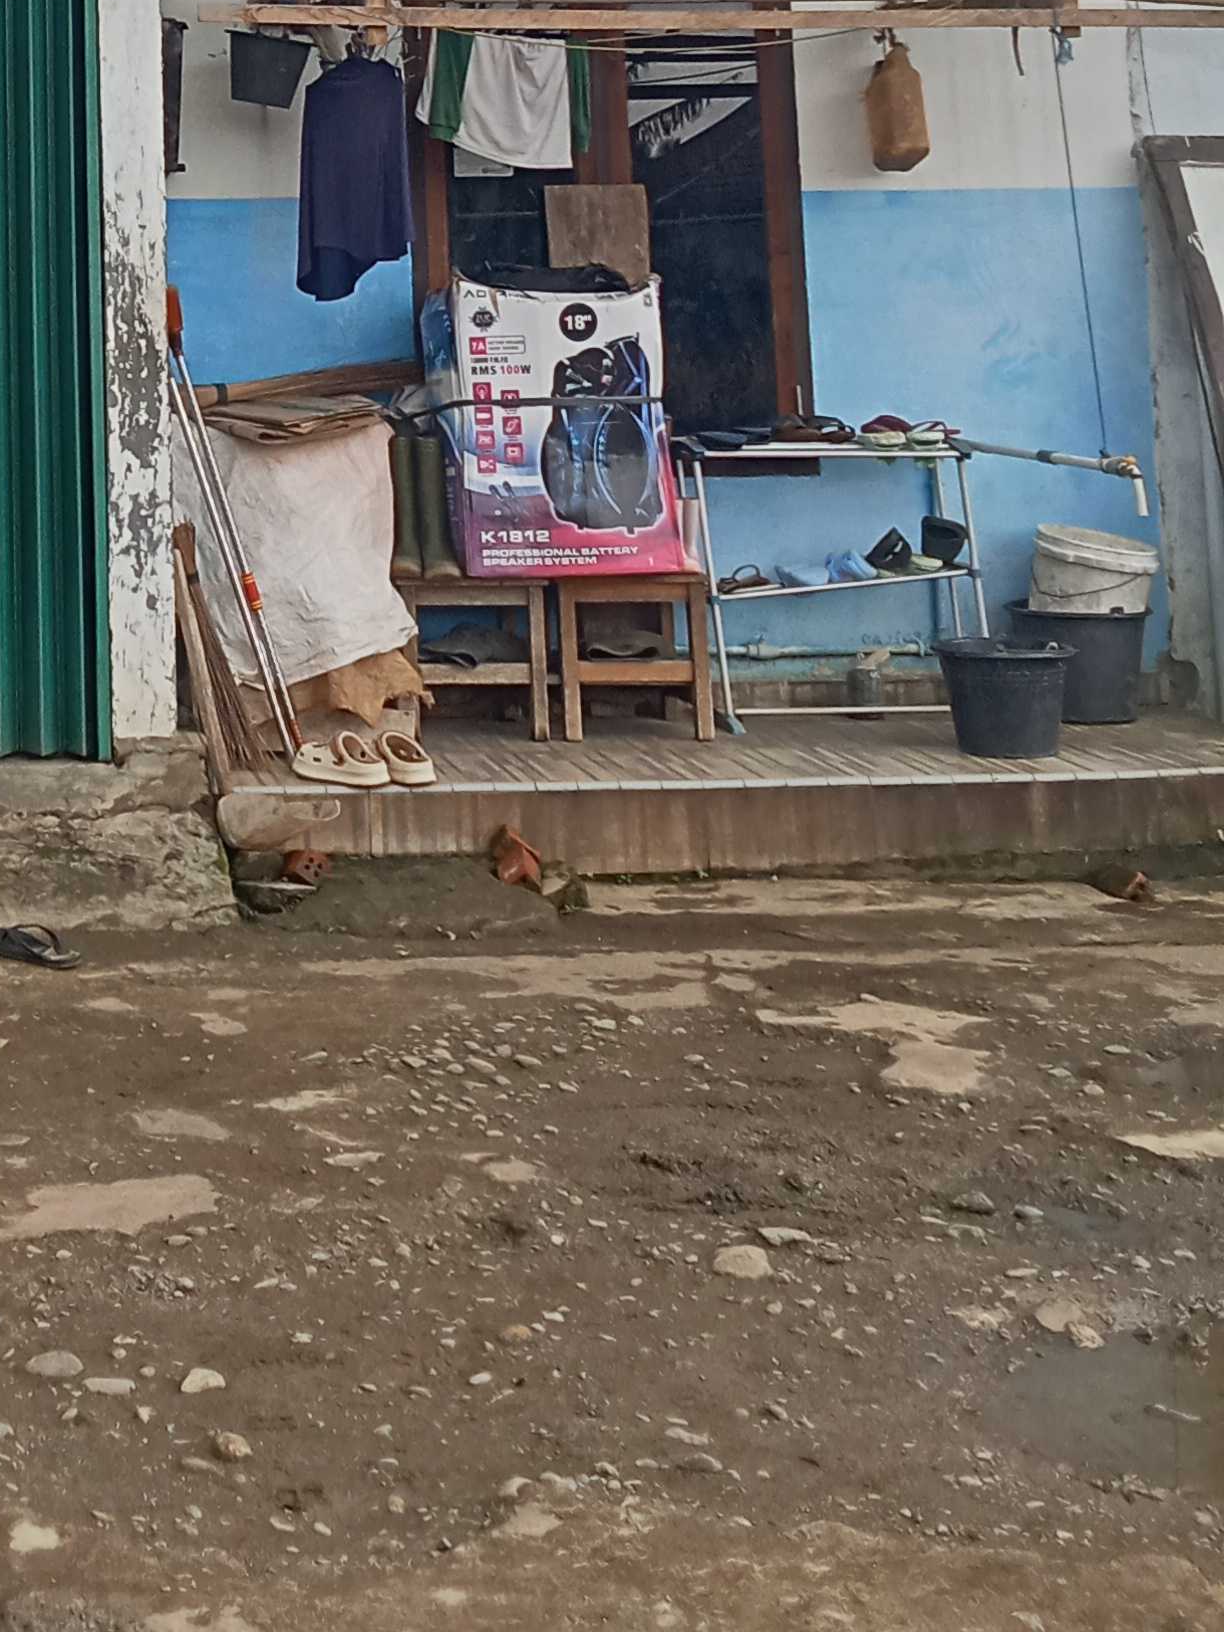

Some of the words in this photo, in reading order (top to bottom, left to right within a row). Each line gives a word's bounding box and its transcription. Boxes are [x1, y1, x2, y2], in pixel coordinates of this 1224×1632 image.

[471, 365, 497, 375] RMS
[500, 364, 532, 375] 100W
[480, 530, 551, 543] K1812
[482, 548, 579, 558] PROFESSIONAL
[580, 546, 639, 556] BATTERY
[483, 557, 544, 567] SPEAKER
[544, 556, 597, 565] SYSTEM
